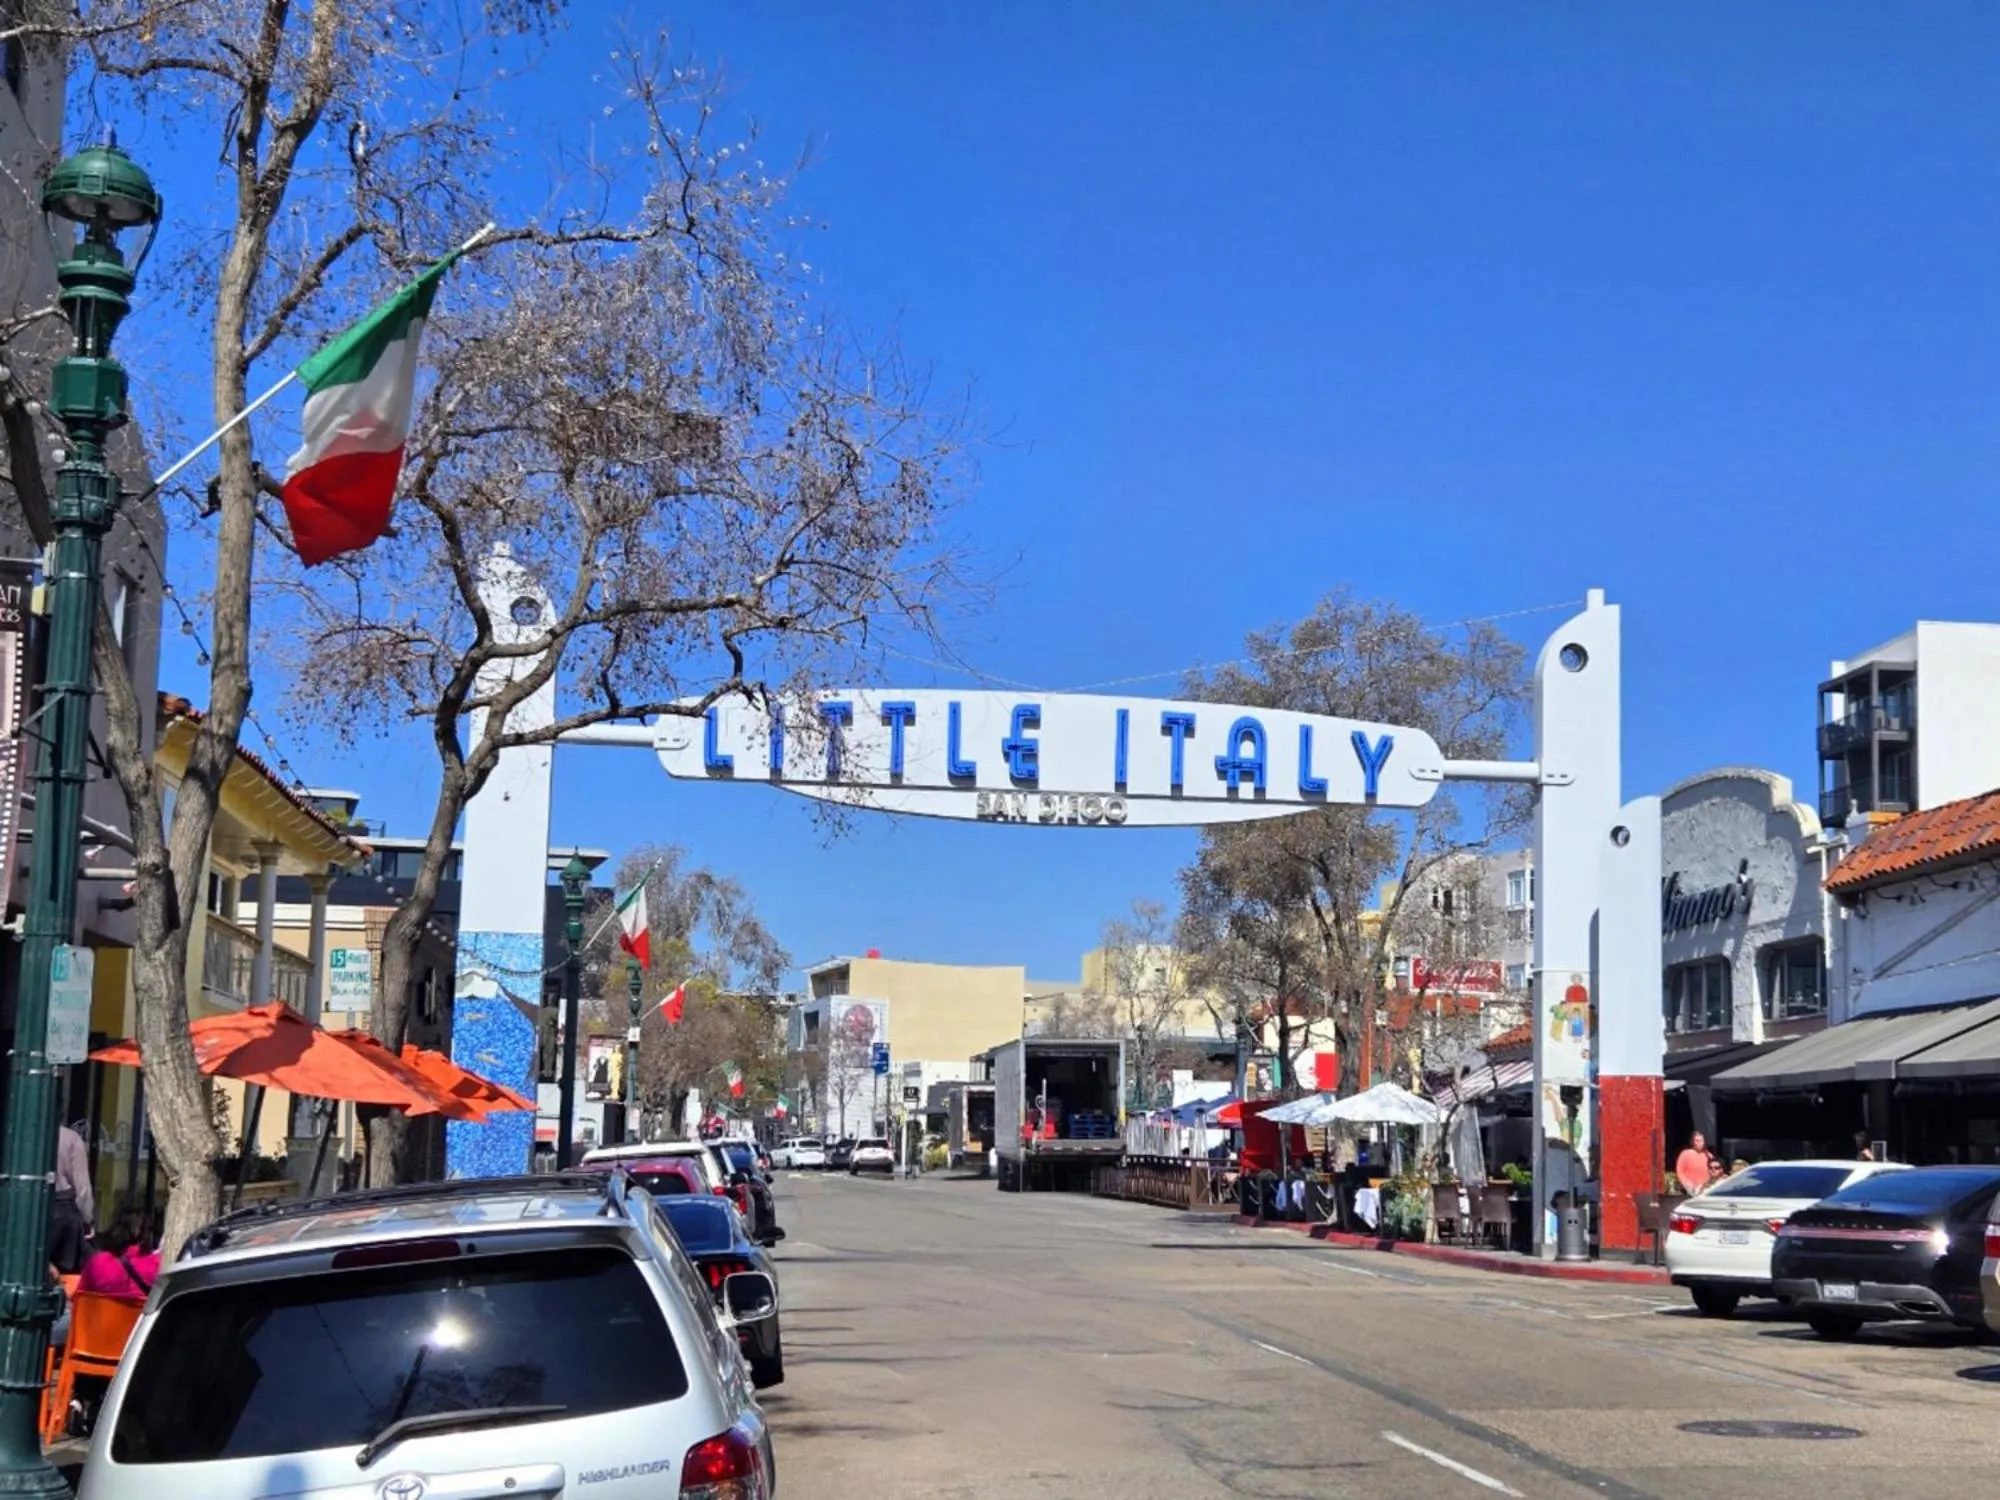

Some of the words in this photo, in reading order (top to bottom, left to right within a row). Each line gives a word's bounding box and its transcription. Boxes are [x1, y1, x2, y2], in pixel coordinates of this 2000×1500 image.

[704, 701, 1041, 781] LITTLE
[1115, 709, 1394, 796] ITALY
[977, 791, 1028, 819] SAN
[1039, 792, 1128, 824] DIEGO
[332, 951, 345, 966] 15
[332, 971, 370, 983] PARKING
[578, 1459, 670, 1485] HIGHLANDER
